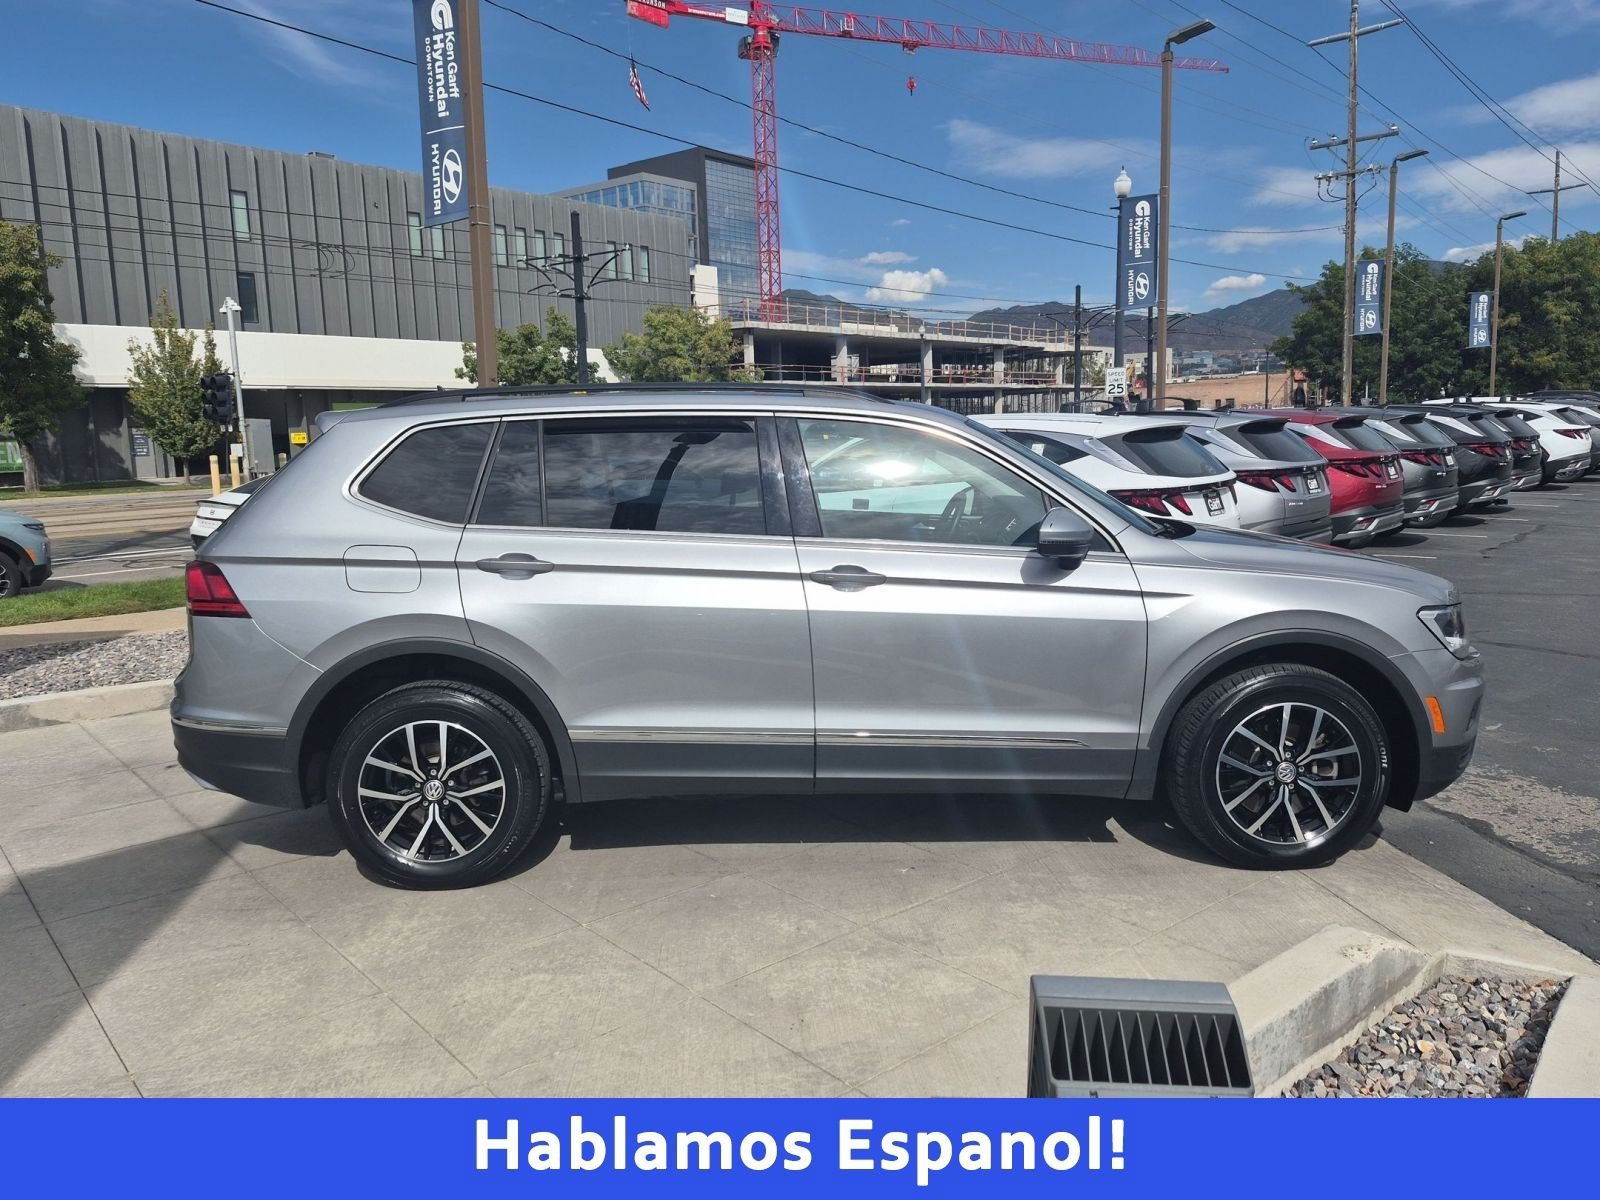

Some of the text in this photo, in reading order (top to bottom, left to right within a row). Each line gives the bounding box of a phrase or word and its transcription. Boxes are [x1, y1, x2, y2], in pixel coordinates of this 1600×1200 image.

[425, 37, 434, 102] DOWNTOWN
[432, 33, 450, 118] Hyundai
[445, 31, 460, 98] Ken Garff
[431, 143, 442, 216] HYUNDAI
[1134, 217, 1143, 258] Hyundai
[1143, 216, 1151, 231] Ken
[1127, 269, 1135, 306] HYUNDAI
[1108, 383, 1125, 395] 25
